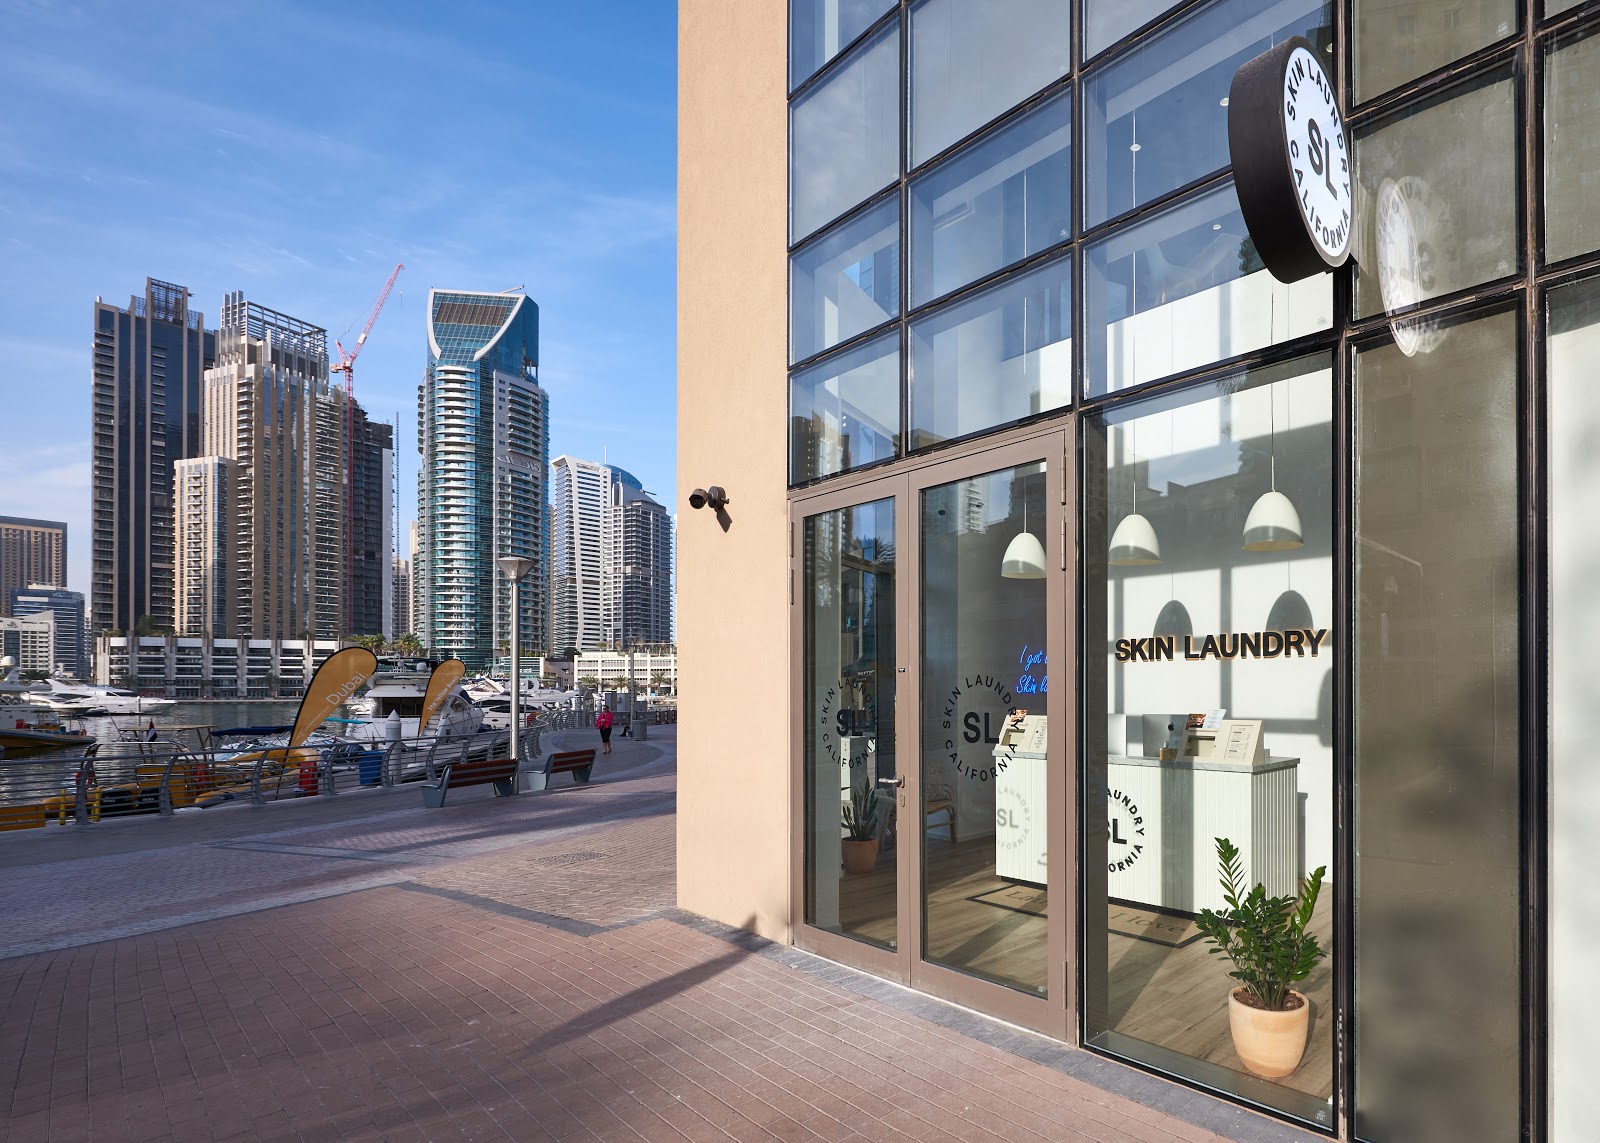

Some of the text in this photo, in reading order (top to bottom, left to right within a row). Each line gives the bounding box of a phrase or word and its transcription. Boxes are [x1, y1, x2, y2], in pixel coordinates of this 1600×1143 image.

[1287, 57, 1350, 198] SKIN LAUNDRY
[1307, 117, 1338, 201] SL
[1290, 139, 1349, 249] CALIFORNIA
[1115, 628, 1328, 663] SKIN LAUNDRY
[820, 688, 835, 725] SKIN
[836, 708, 864, 737] SL
[943, 674, 1021, 731] SKIN LAUNDRY
[963, 711, 999, 744] SL
[822, 733, 876, 769] CALIFORNIA
[945, 740, 1018, 781] CALIFORNIA
[1108, 788, 1145, 836] AUNDRY
